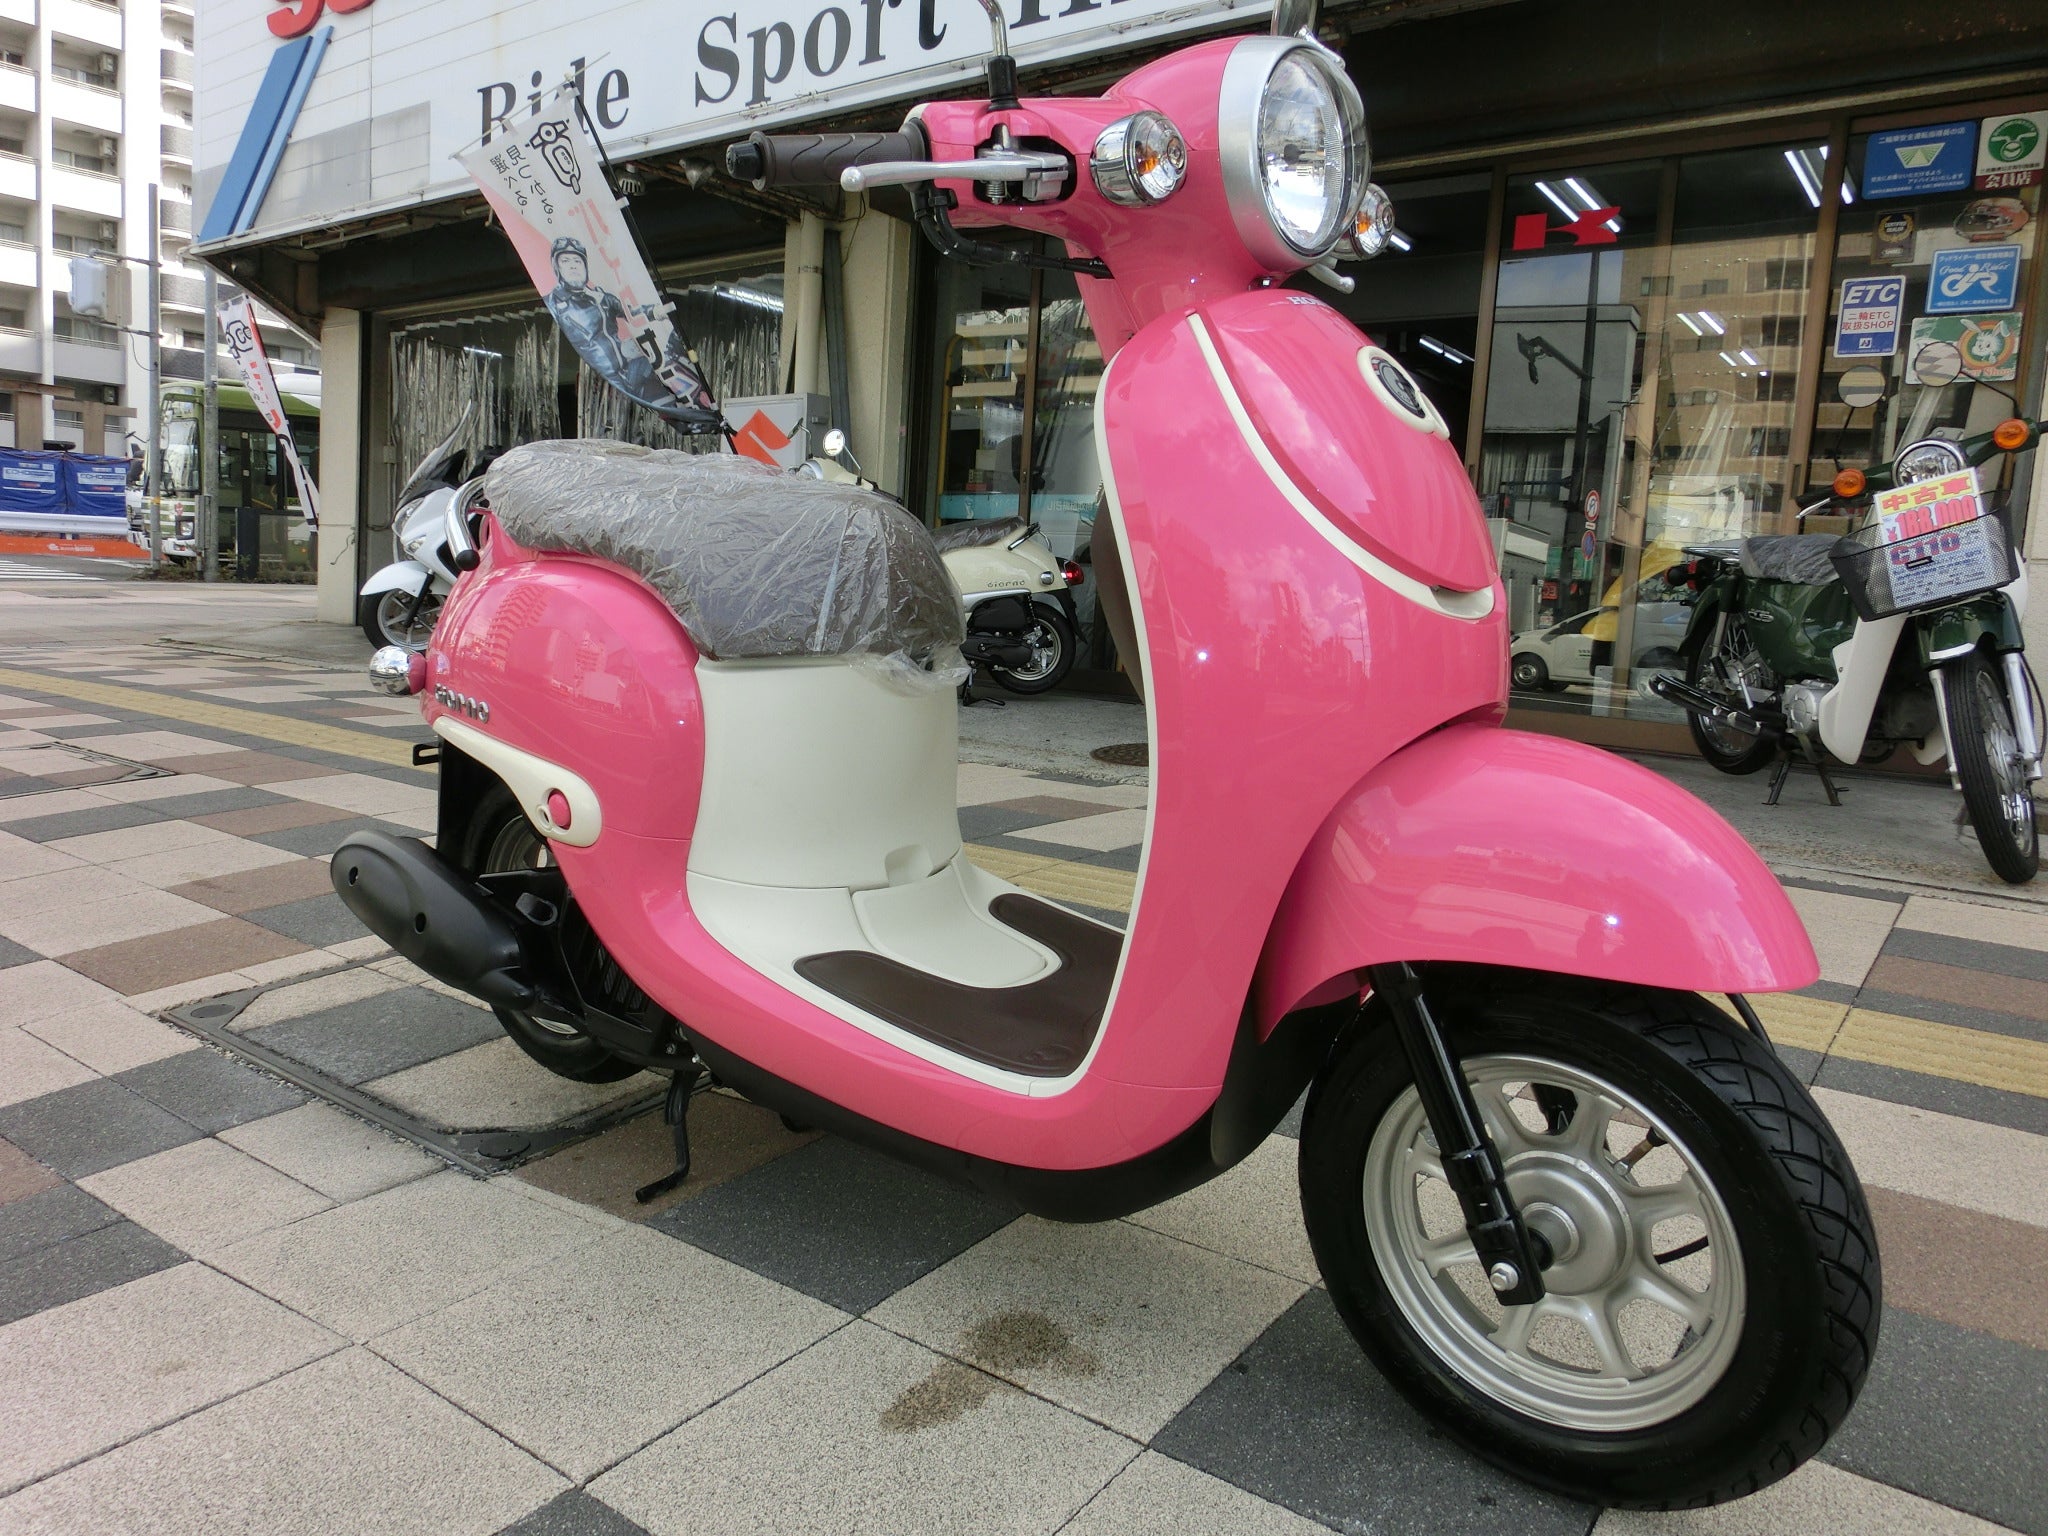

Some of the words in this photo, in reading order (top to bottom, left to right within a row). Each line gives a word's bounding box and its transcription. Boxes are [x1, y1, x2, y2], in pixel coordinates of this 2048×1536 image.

[1985, 171, 2031, 188] 会員店
[1844, 283, 1900, 304] ETC
[1848, 311, 1890, 320] 二輪ETC
[1882, 476, 1971, 511] 中古車
